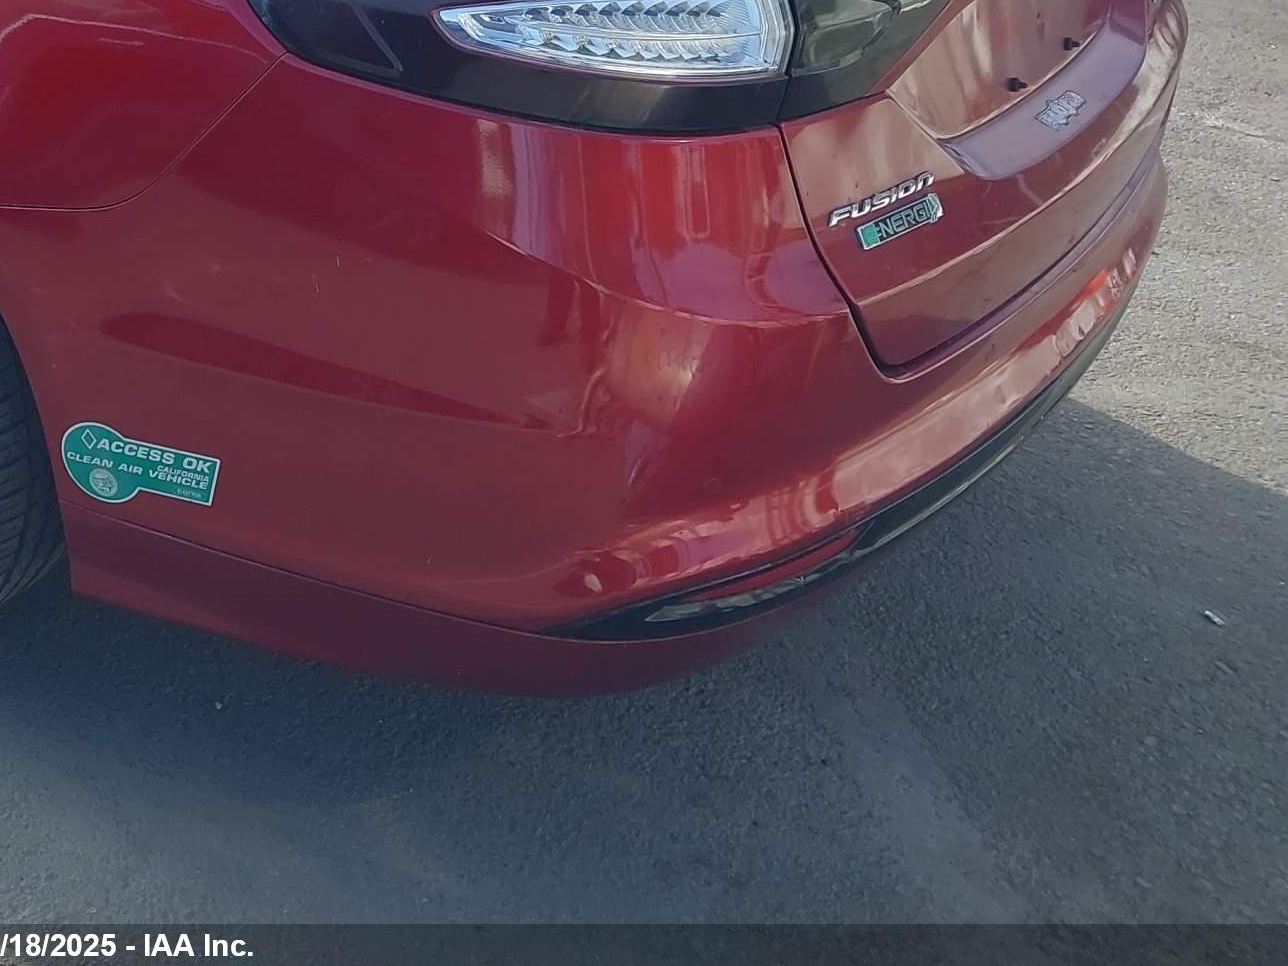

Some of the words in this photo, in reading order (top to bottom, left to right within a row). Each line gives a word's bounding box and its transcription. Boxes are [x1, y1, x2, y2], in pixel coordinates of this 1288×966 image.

[827, 171, 935, 227] FUSION
[66, 451, 114, 468] CLEAN
[117, 463, 144, 475] AIR
[148, 470, 209, 490] VEHICLE
[96, 438, 175, 465] ACCESS
[182, 457, 212, 474] OK
[157, 465, 210, 483] CALIFORNIA
